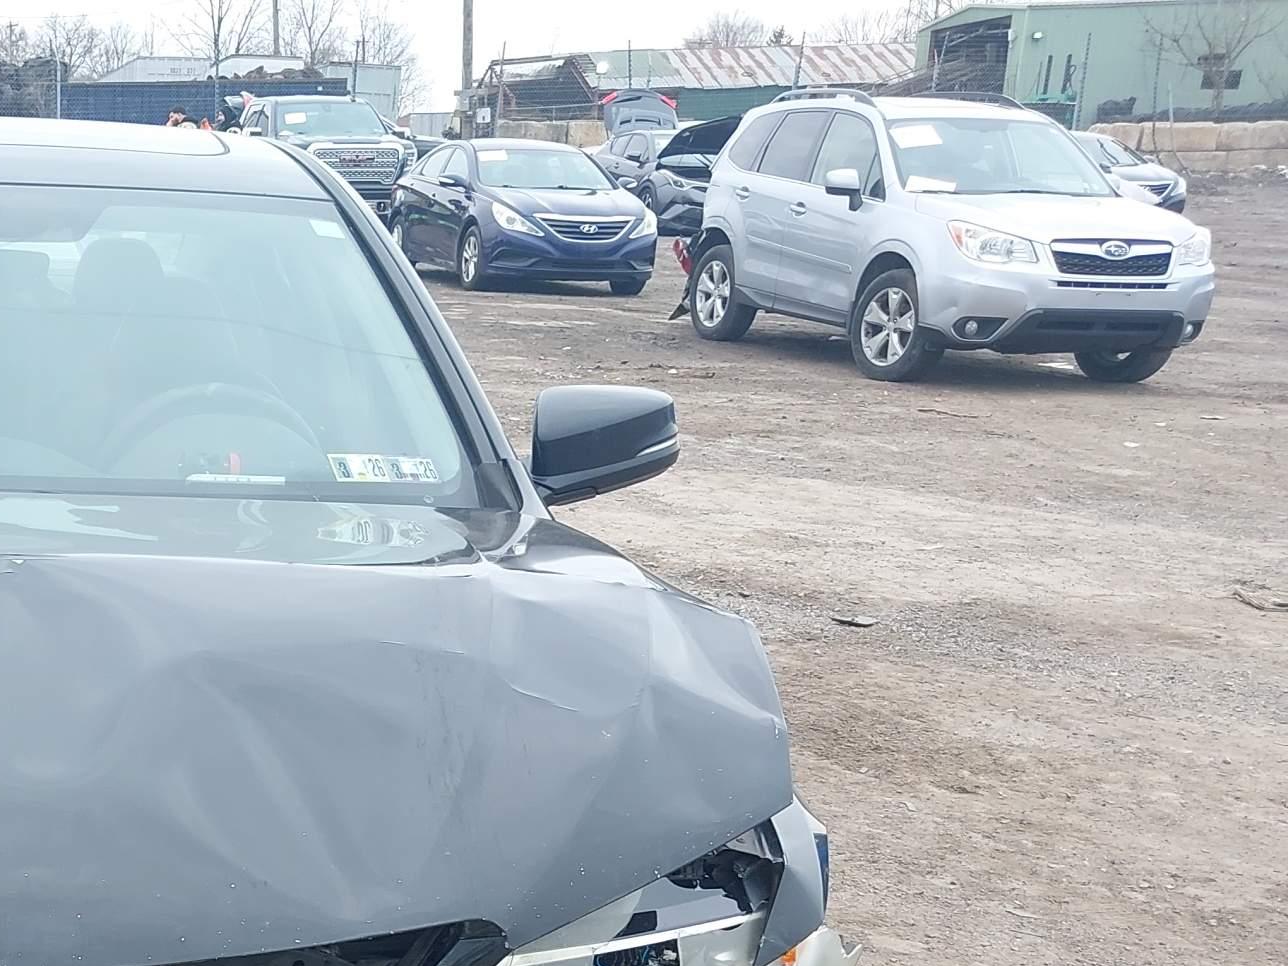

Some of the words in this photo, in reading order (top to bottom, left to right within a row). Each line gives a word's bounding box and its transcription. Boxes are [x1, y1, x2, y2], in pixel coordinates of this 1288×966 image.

[338, 462, 351, 479] 3
[368, 458, 386, 477] 26
[391, 463, 404, 479] 3
[419, 461, 438, 480] 26
